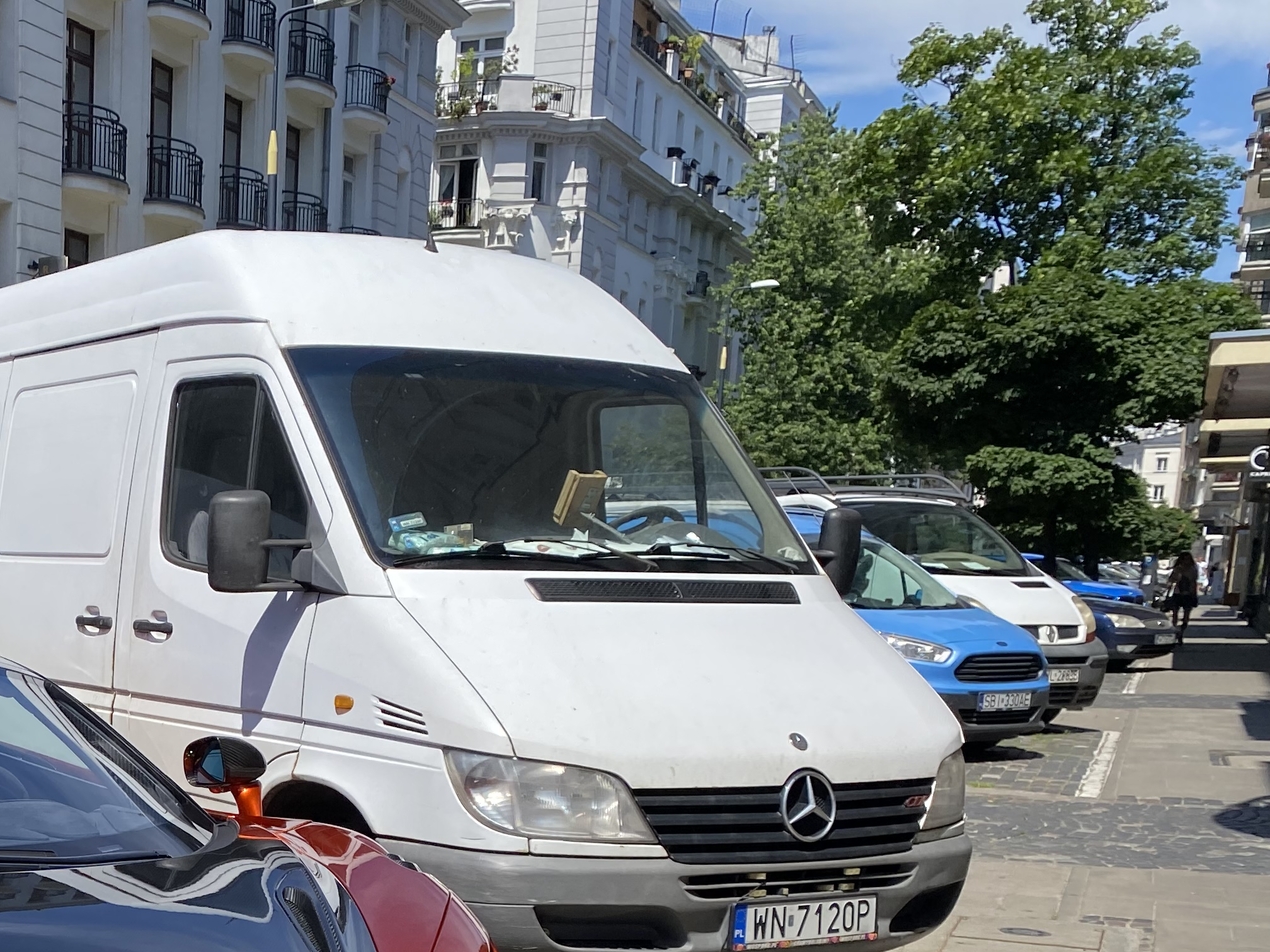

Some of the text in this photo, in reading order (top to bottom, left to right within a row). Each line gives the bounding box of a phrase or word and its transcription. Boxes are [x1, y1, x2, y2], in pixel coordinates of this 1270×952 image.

[984, 693, 1030, 708] SBI 330AE
[733, 899, 870, 941] PL WN 7120P
